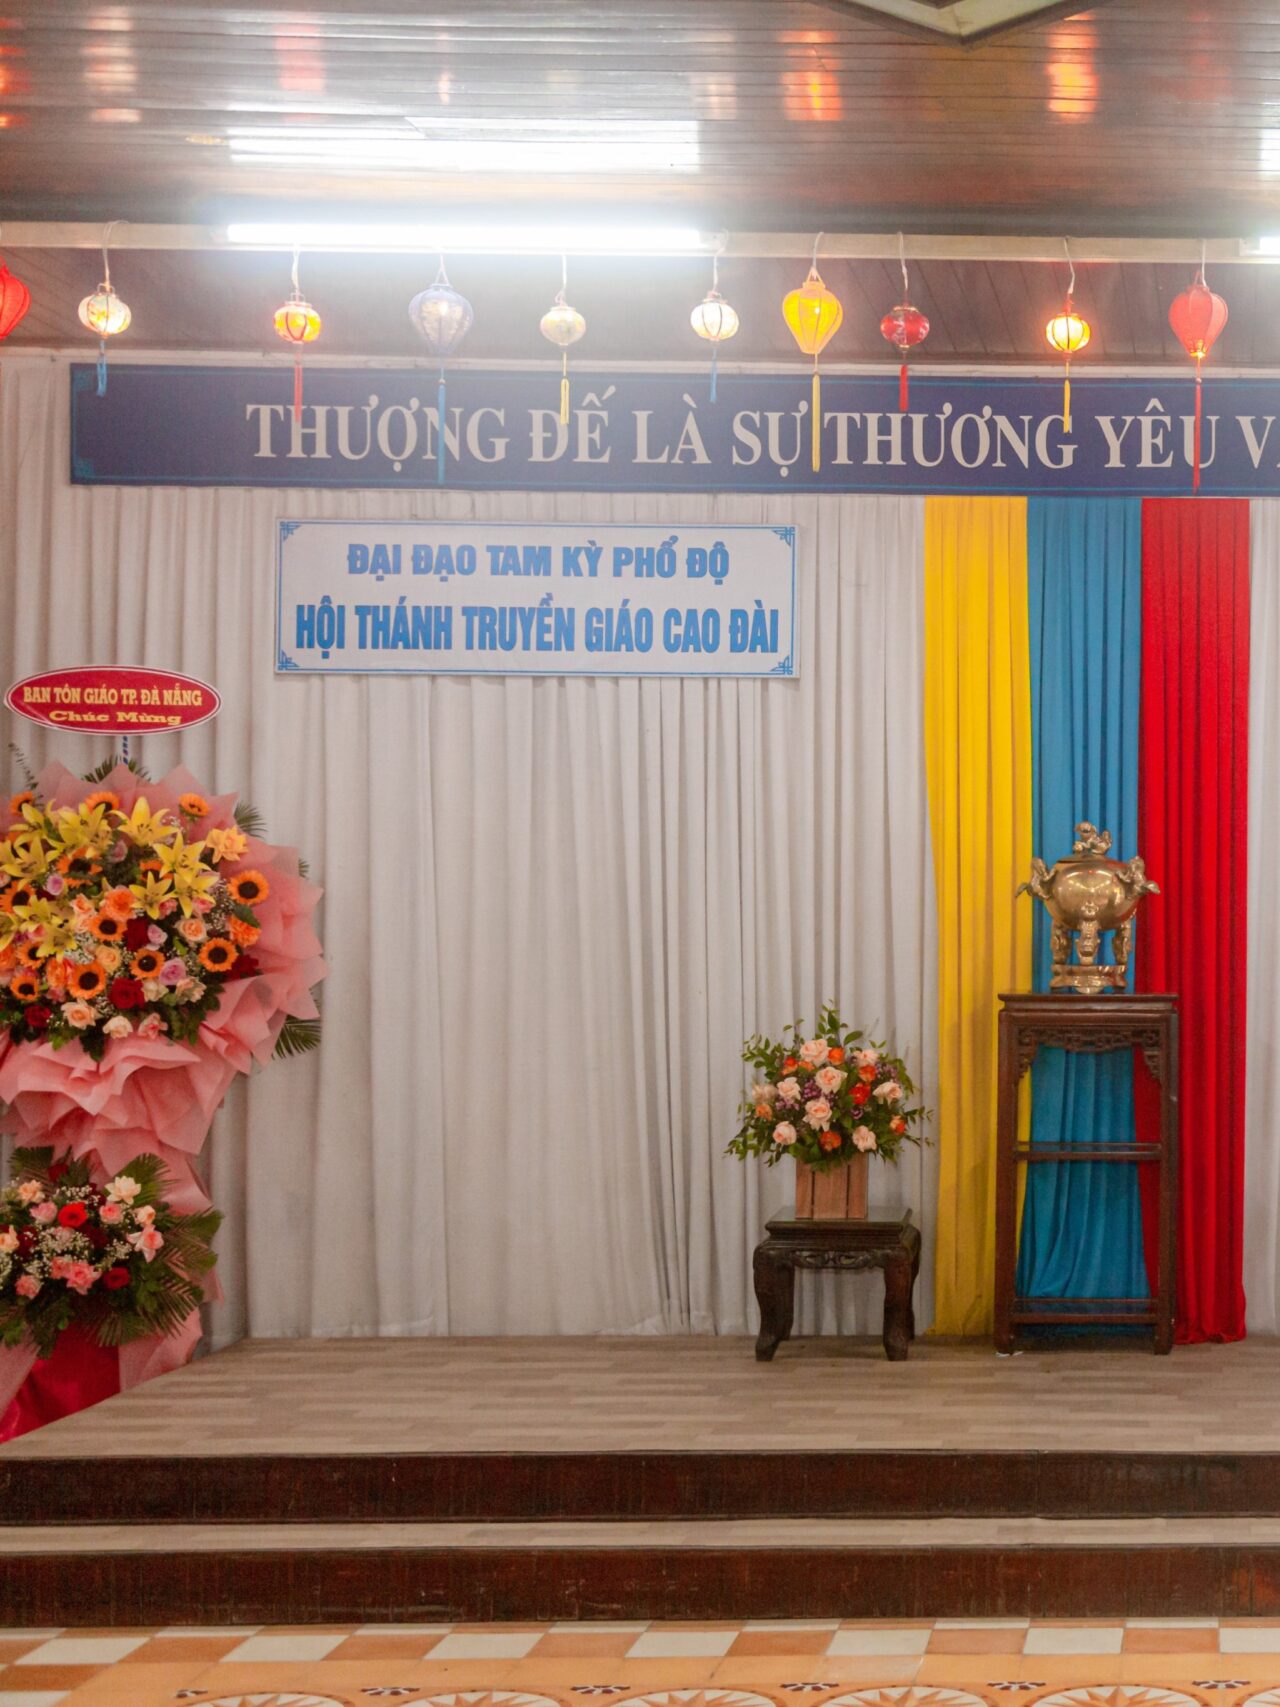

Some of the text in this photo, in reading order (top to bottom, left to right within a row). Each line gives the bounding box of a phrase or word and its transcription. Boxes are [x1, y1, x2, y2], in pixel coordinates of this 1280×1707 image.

[246, 394, 510, 473] THƯỢNG
[527, 385, 616, 464] ĐẾ
[632, 393, 711, 464] LÀ
[731, 402, 808, 478] SỰ
[823, 401, 1077, 469] THƯƠNG
[1094, 398, 1220, 471] YÊU
[347, 535, 730, 586] ĐẠI ĐẠO TAM KỲ PHỔ ĐỘ
[296, 592, 780, 659] HỘI THÁNH TRUYỀN GIÁO CAO ĐÀI
[23, 686, 51, 703] BAN
[54, 683, 81, 704] TÔN
[84, 684, 118, 704] GIÁO
[120, 688, 138, 704] TP.
[140, 685, 160, 705] ĐÀ
[50, 710, 182, 725] Chúc Mừng
